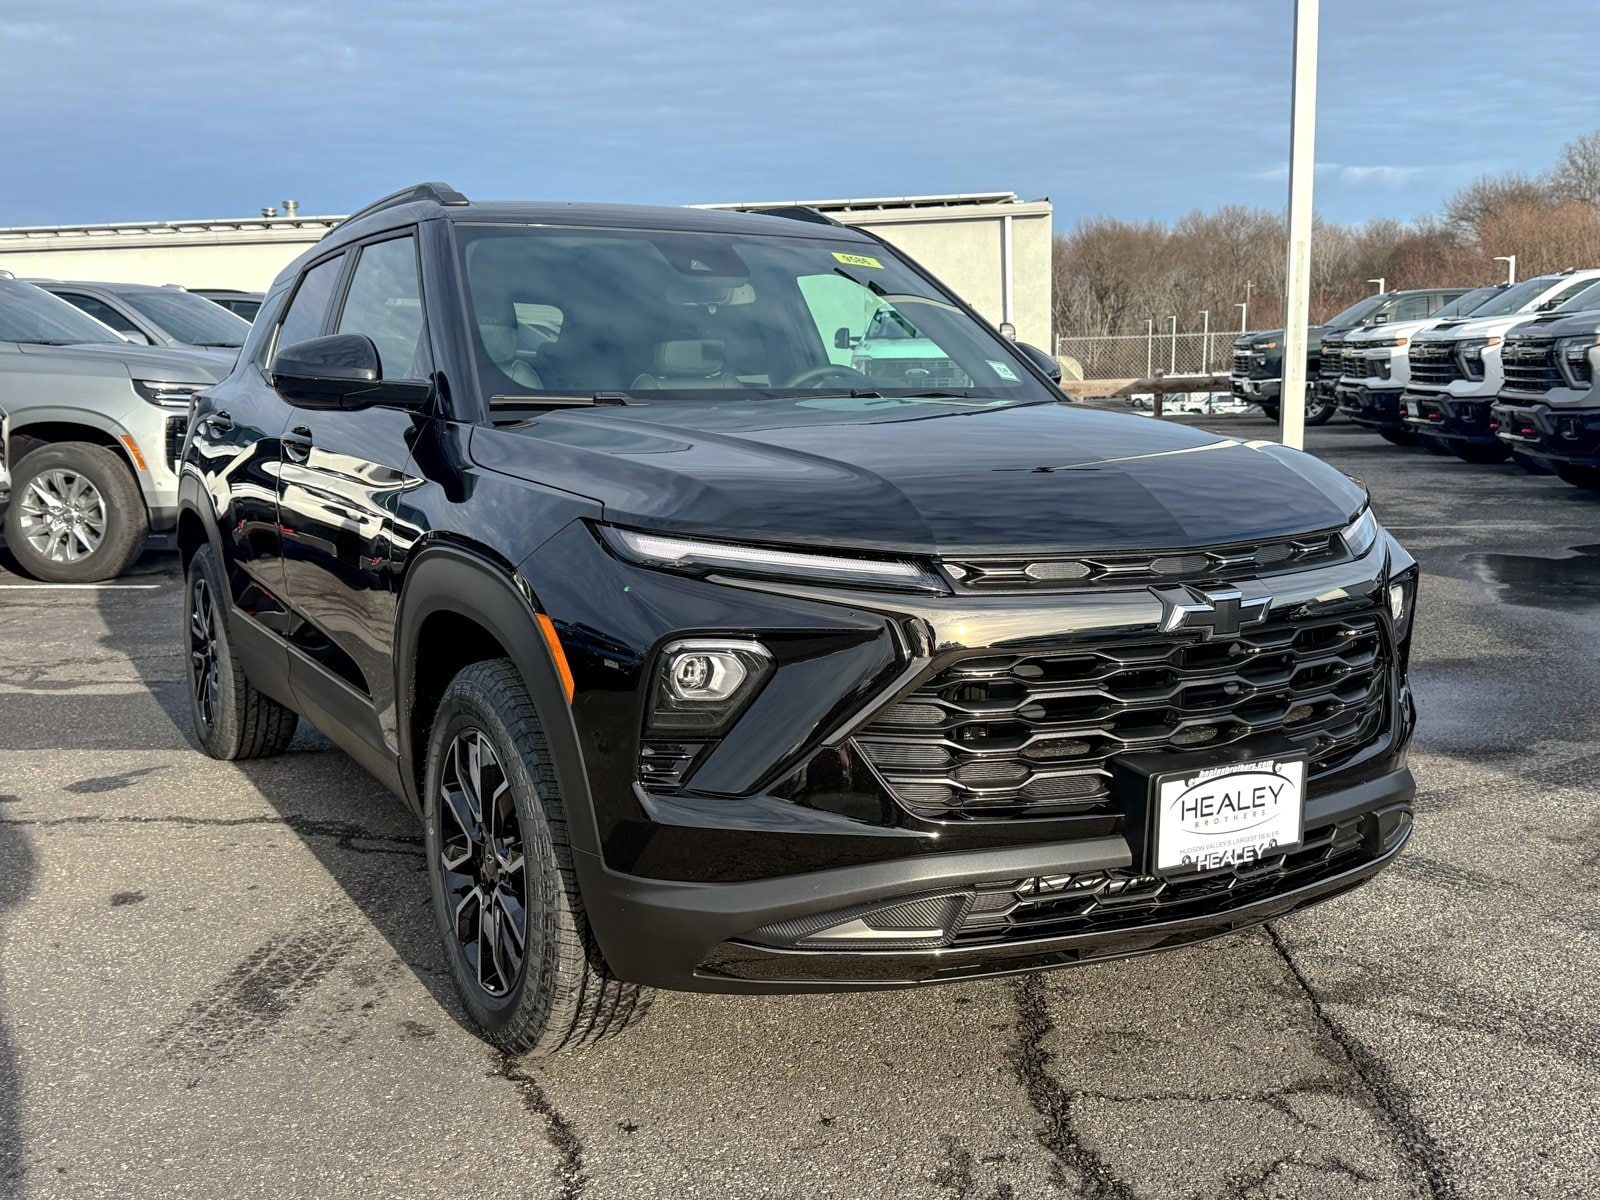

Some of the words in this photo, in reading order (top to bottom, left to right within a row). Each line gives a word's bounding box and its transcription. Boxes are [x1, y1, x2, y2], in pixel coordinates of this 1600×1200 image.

[841, 255, 871, 265] 9586
[1199, 760, 1274, 778] healeybrothers.com
[1181, 783, 1285, 821] HEALEY
[1195, 810, 1266, 828] BROTHERS
[1179, 846, 1205, 854] HUDSON
[1205, 840, 1232, 850] VALLEY'S
[1232, 835, 1257, 845] LARGEST
[1258, 830, 1280, 840] DEALER
[1196, 844, 1265, 872] HEALEY
